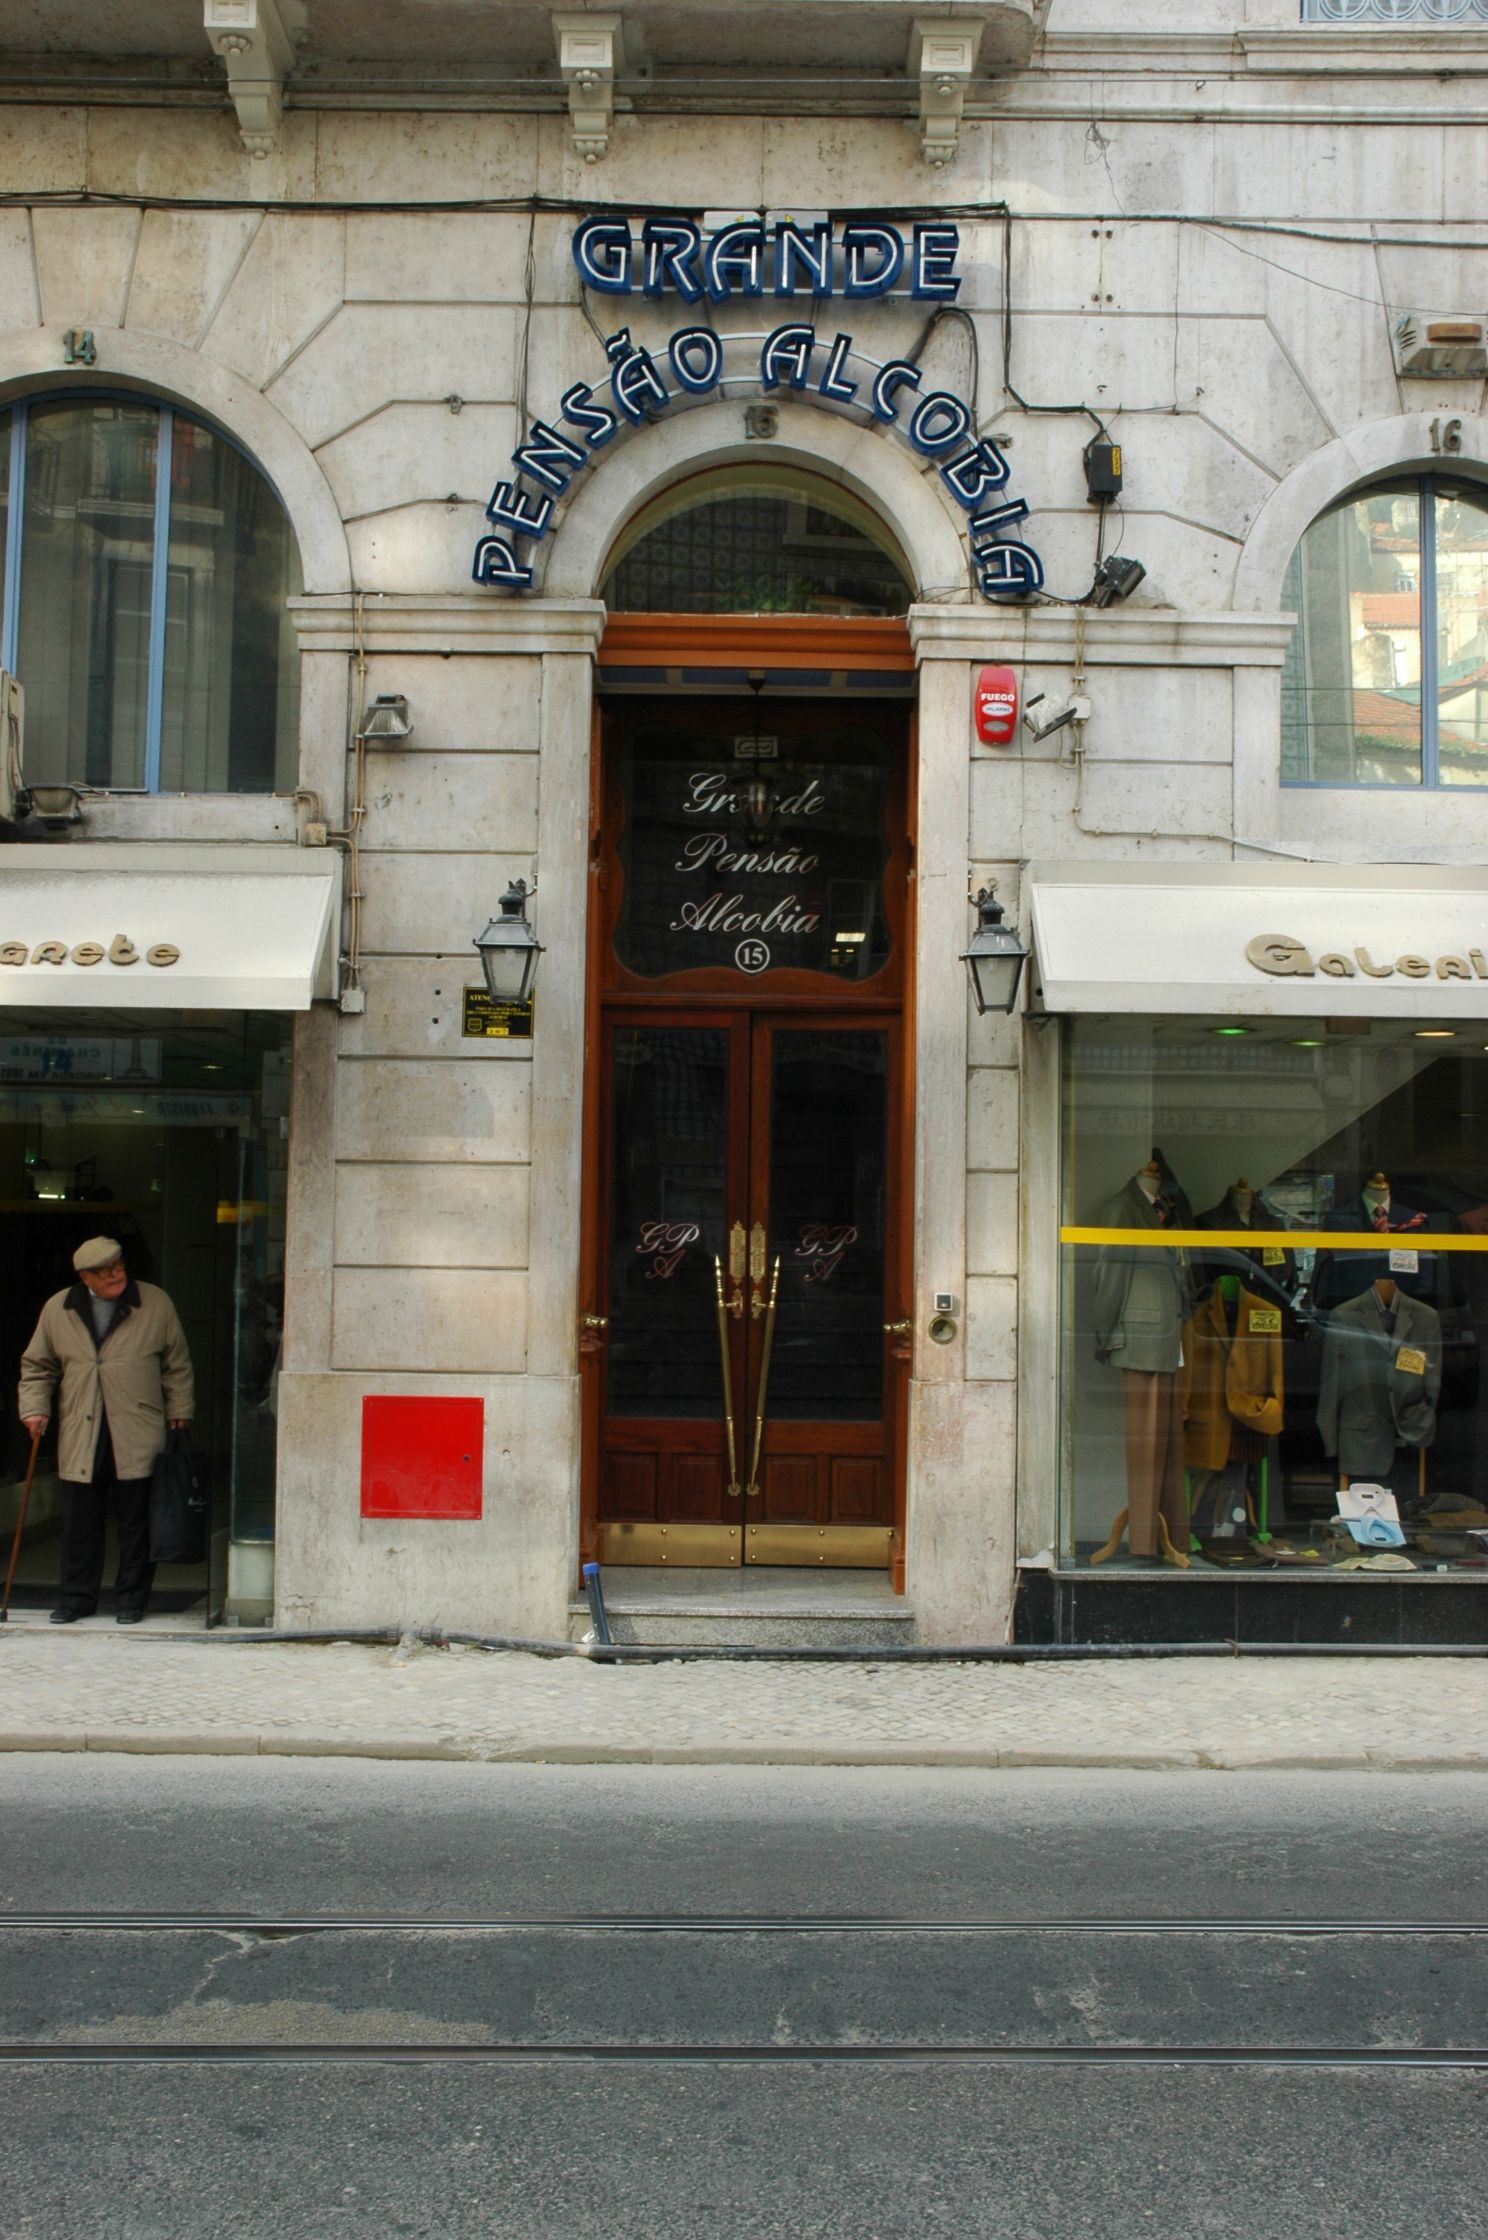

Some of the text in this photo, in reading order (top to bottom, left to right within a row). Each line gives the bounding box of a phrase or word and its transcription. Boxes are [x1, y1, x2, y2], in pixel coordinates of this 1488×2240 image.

[572, 216, 960, 304] GRANDE
[63, 329, 96, 365] 14
[744, 405, 778, 440] 15
[1429, 417, 1462, 451] 16
[472, 322, 1045, 594] PENSÃO ALCOBIA
[980, 692, 1016, 703] FUEGO
[683, 773, 825, 815] Grde
[675, 832, 820, 873] Pensão
[670, 892, 821, 933] Alcobia
[741, 948, 764, 965] 15
